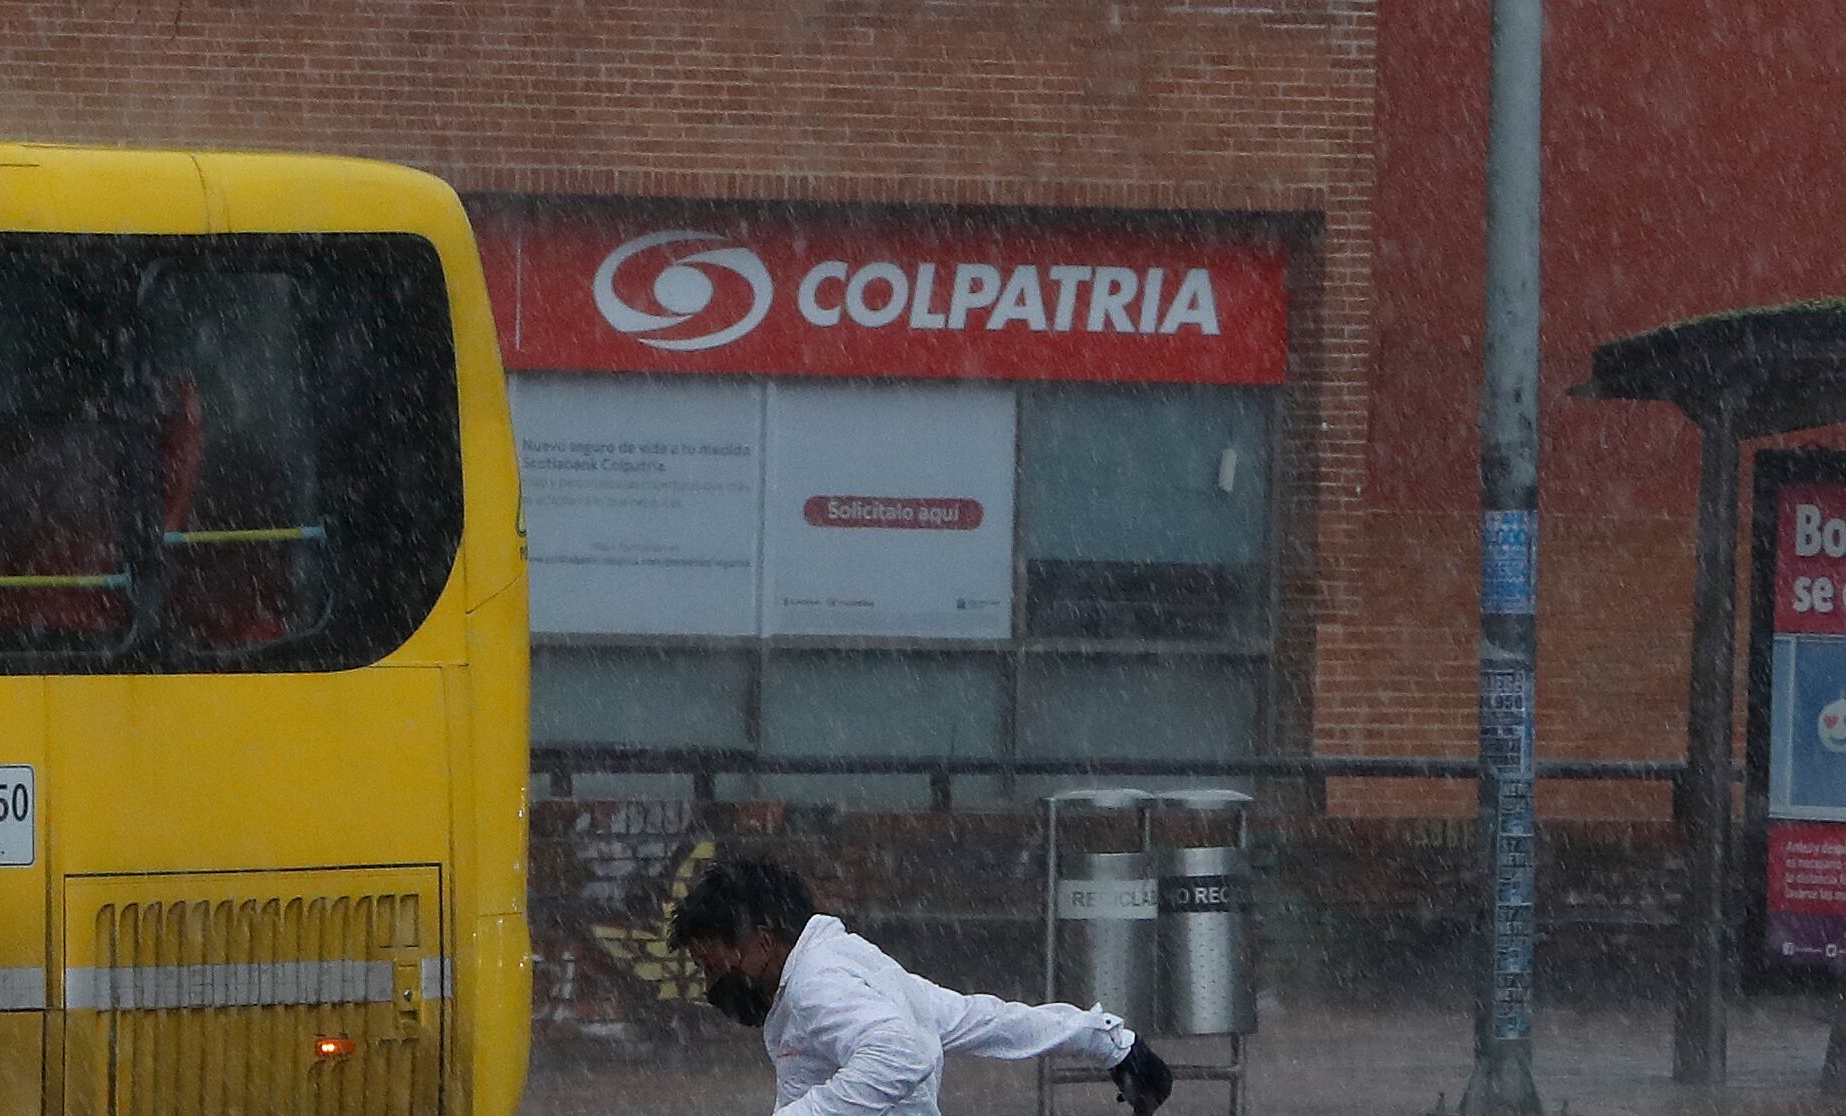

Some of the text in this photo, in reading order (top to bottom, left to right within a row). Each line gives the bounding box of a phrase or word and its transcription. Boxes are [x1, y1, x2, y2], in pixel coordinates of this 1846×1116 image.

[797, 259, 1221, 336] COLPATRIA
[521, 438, 565, 453] Nuevo
[569, 441, 615, 456] seguro
[618, 440, 635, 454] de
[638, 441, 667, 454] vida
[1792, 576, 1835, 613] se
